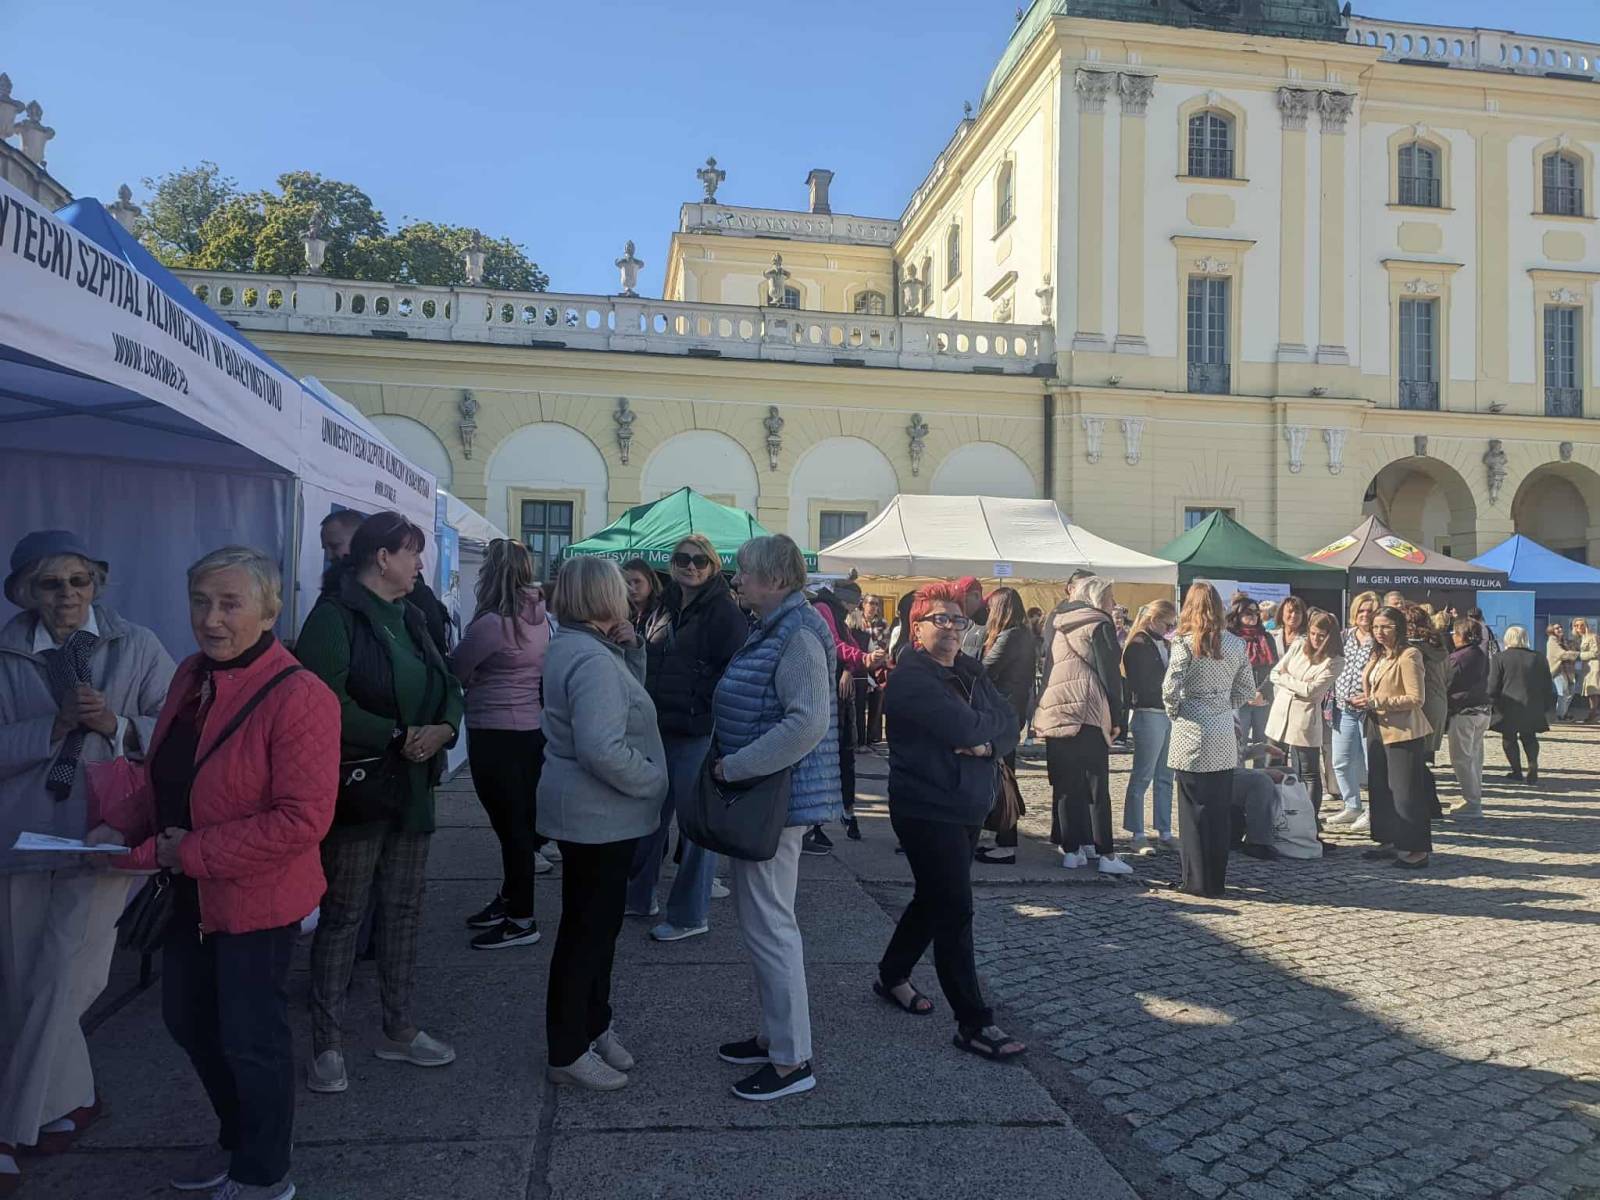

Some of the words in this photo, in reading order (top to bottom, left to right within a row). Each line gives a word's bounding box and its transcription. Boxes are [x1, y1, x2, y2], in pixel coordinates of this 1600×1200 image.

[76, 239, 142, 317] SZPITAL
[147, 280, 210, 361] KLINICZNY
[210, 333, 223, 370] W
[221, 341, 282, 411] BIAŁYMSTOKU
[112, 332, 189, 395] WWW.USKWB.PL
[1356, 575, 1368, 584] IM.
[1371, 575, 1391, 584] GEN.
[1394, 575, 1421, 585] BRYG.
[1423, 576, 1468, 585] NIKODEMA
[1470, 578, 1502, 588] SULIKA
